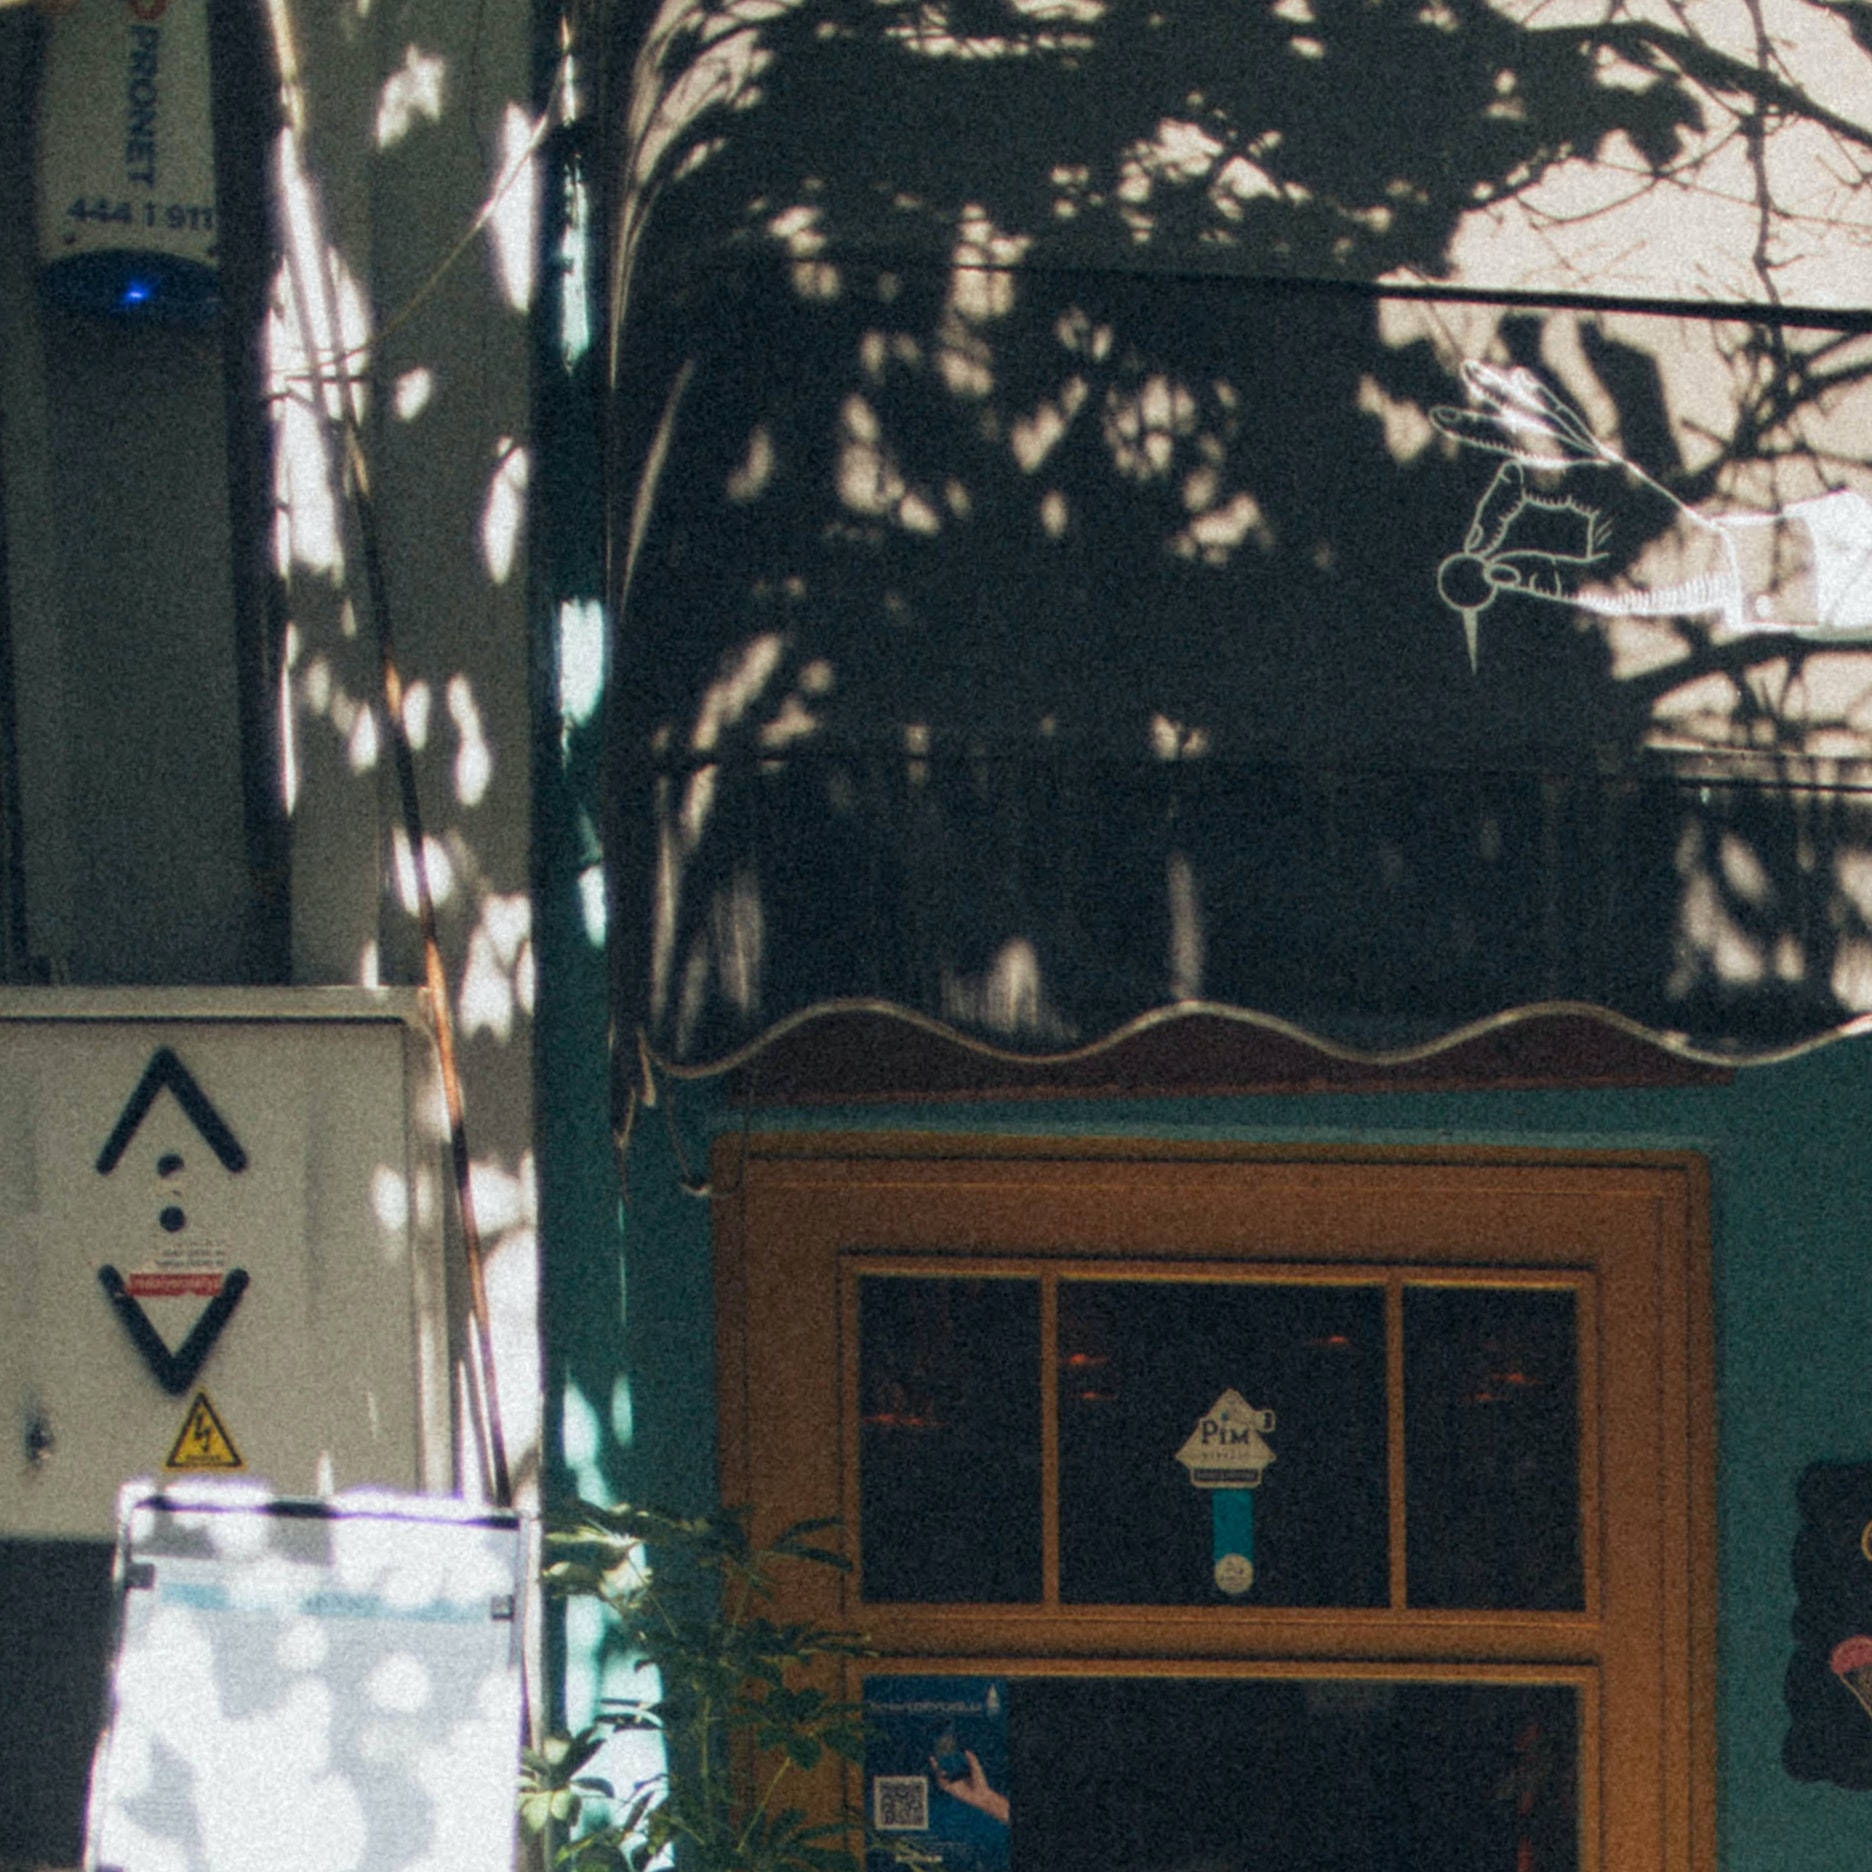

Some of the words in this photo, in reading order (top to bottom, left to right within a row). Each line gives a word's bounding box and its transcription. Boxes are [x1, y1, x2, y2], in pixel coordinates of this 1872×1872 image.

[126, 24, 160, 188] PRONET
[66, 196, 133, 225] 444
[143, 199, 157, 227] 1
[164, 203, 215, 231] 911
